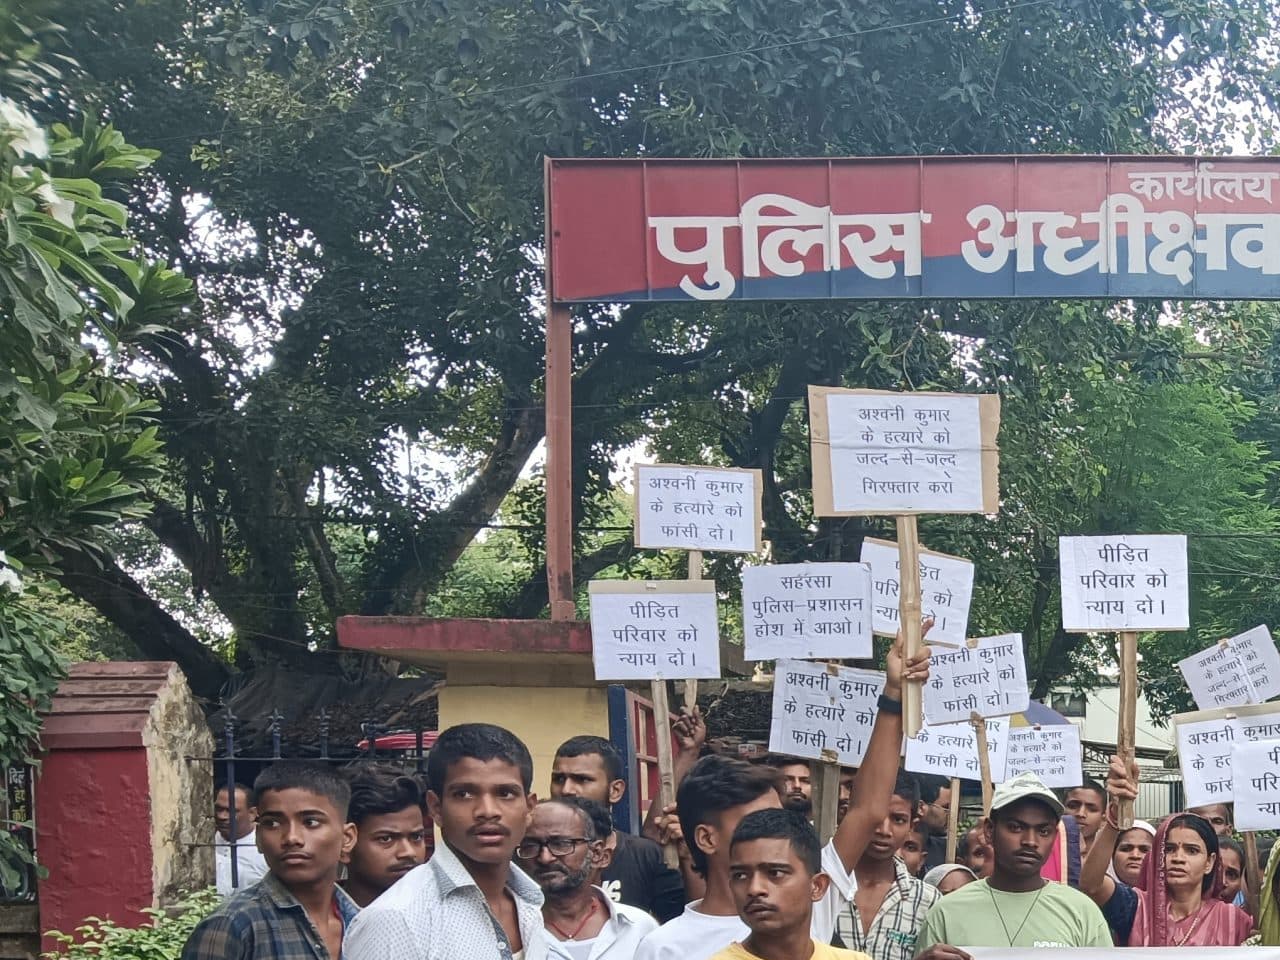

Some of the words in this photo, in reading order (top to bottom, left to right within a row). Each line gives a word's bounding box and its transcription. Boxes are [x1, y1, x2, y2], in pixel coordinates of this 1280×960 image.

[646, 193, 933, 300] पुलिस
[858, 405, 904, 421] अश्वनी
[915, 409, 950, 426] कुमार
[862, 426, 874, 443] के
[884, 427, 923, 444] हत्यारे
[933, 428, 950, 444] को
[649, 472, 698, 490] अश्वनी
[706, 478, 744, 496] कुमार
[863, 477, 919, 493] गिरफ्तार
[928, 471, 953, 493] करो
[650, 498, 663, 513] के
[674, 500, 714, 517] हत्यारे
[725, 503, 742, 518] को
[662, 522, 699, 539] फांसी
[1097, 543, 1150, 565] पीड़ित
[781, 573, 832, 589] सहरसा
[1080, 570, 1136, 588] परिवार
[1146, 568, 1168, 588] को
[934, 589, 952, 607] को
[1084, 601, 1124, 614] न्याय
[629, 601, 680, 621] पीड़ित
[612, 625, 666, 643] परिवार
[678, 624, 698, 641] को
[754, 620, 784, 637] होश
[793, 619, 803, 636] में
[618, 653, 656, 666] न्याय
[928, 645, 971, 666] अश्वनी
[979, 644, 1014, 664] कुमार
[786, 671, 830, 690] अश्वनी
[839, 682, 878, 700] कुमार
[931, 673, 943, 690] के
[953, 668, 989, 687] हत्यारे
[999, 665, 1015, 682] को
[784, 696, 797, 713] के
[805, 703, 846, 722] हत्यारे
[856, 708, 875, 726] को
[943, 693, 977, 712] फांसी
[792, 728, 826, 747] फांसी
[916, 729, 928, 743] के
[938, 735, 973, 749] हत्यारे
[1188, 726, 1234, 745] अश्वनी
[1244, 724, 1280, 740] कुमार
[926, 753, 957, 768] फांसी
[1191, 755, 1204, 770] के
